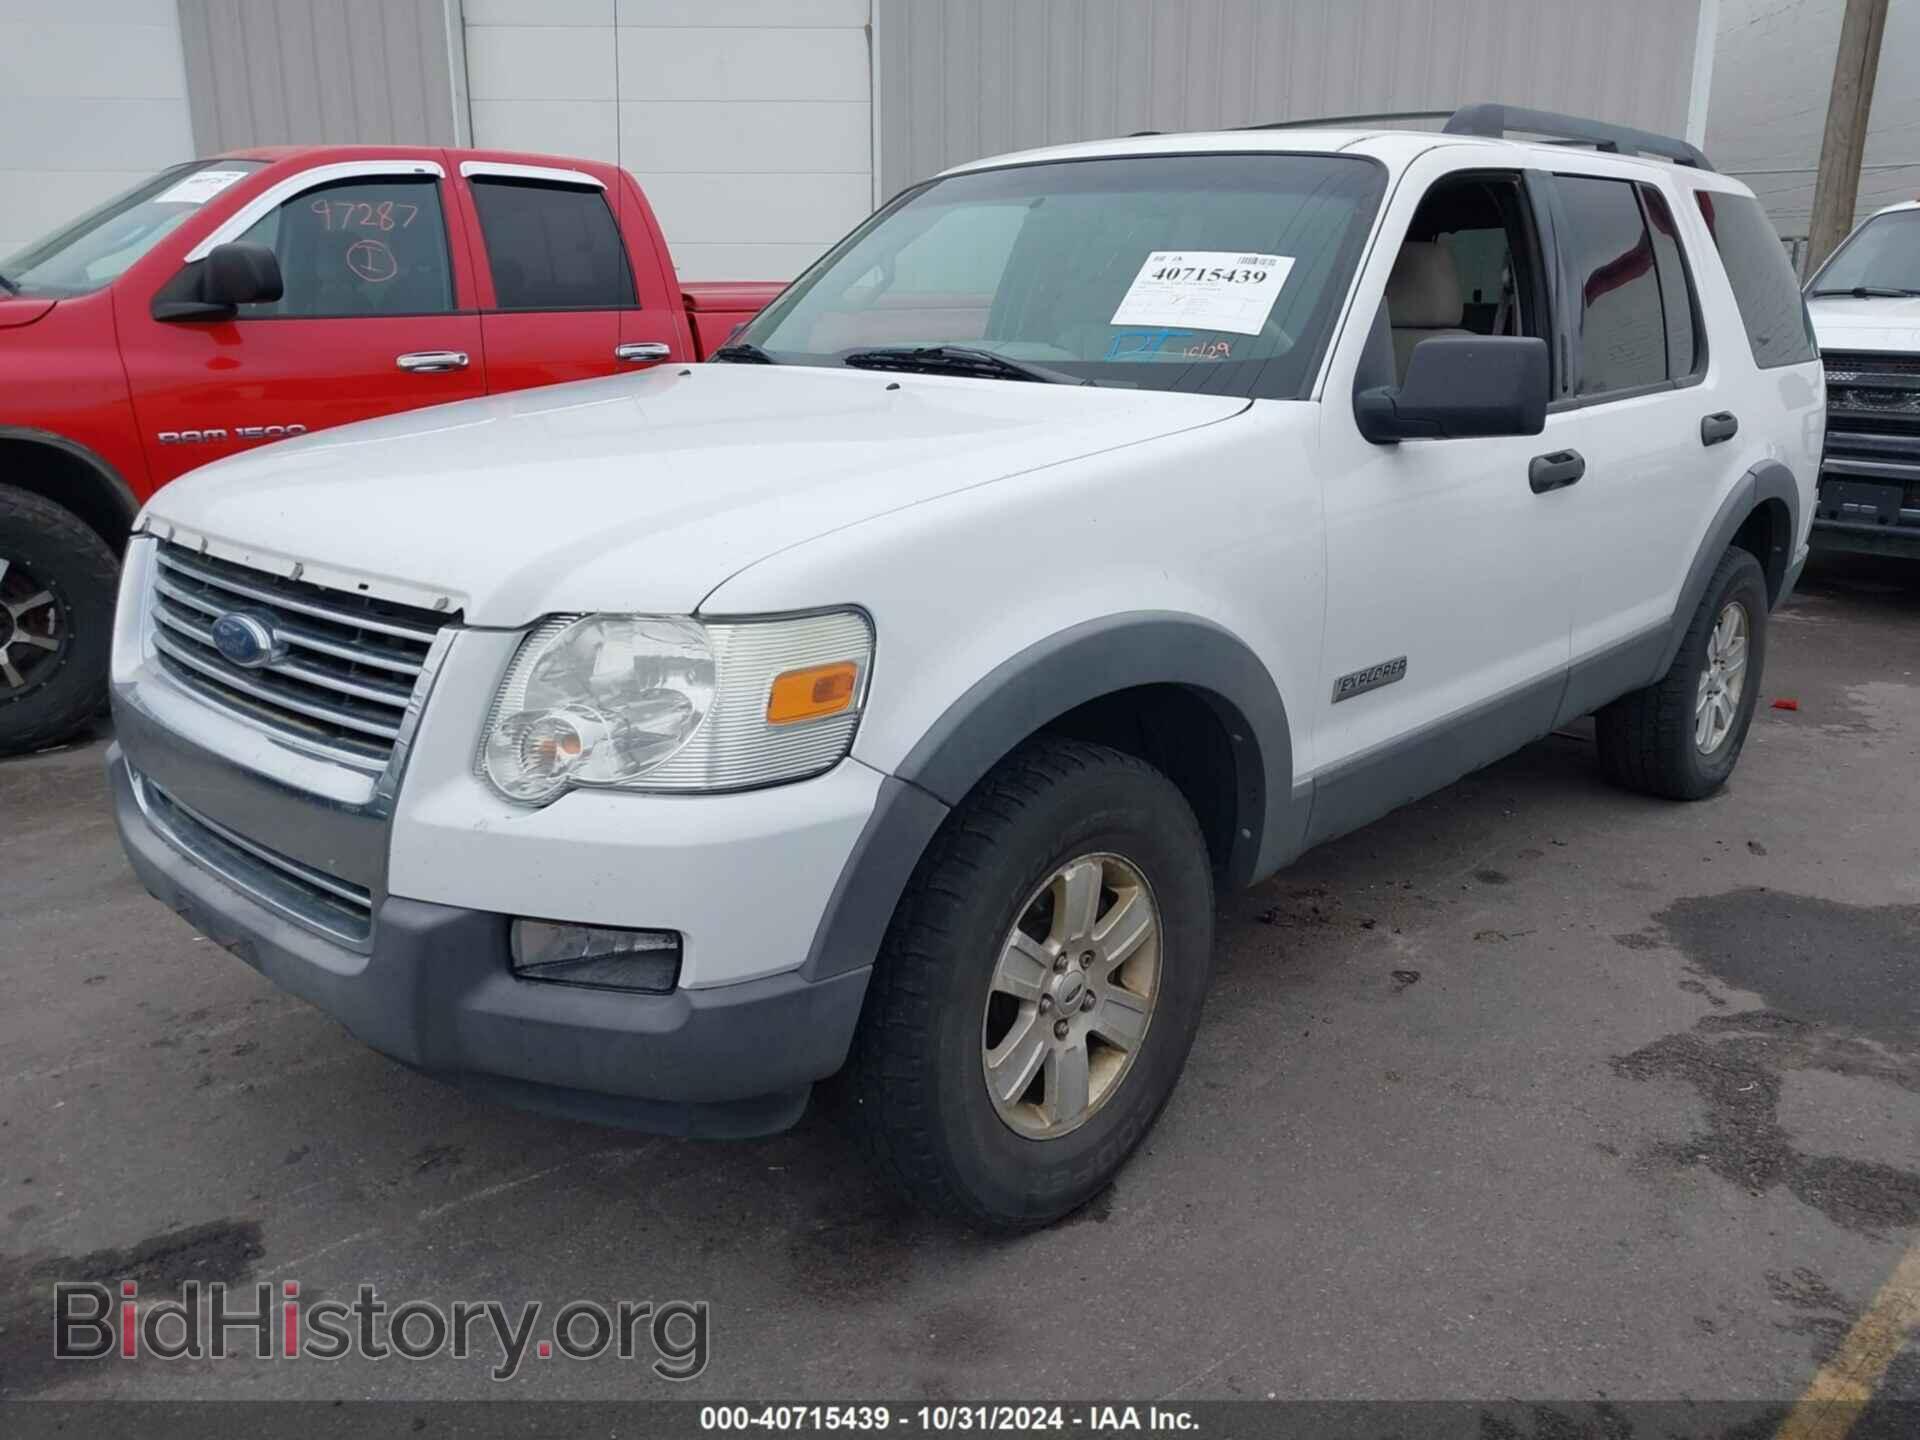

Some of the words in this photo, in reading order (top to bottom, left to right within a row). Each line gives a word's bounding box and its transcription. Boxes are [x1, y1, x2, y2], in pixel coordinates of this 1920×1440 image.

[311, 199, 418, 231] 97287
[1152, 266, 1267, 284] 40715439
[158, 429, 228, 443] RAM
[235, 424, 307, 438] 1500
[1340, 659, 1407, 691] EXPLORER
